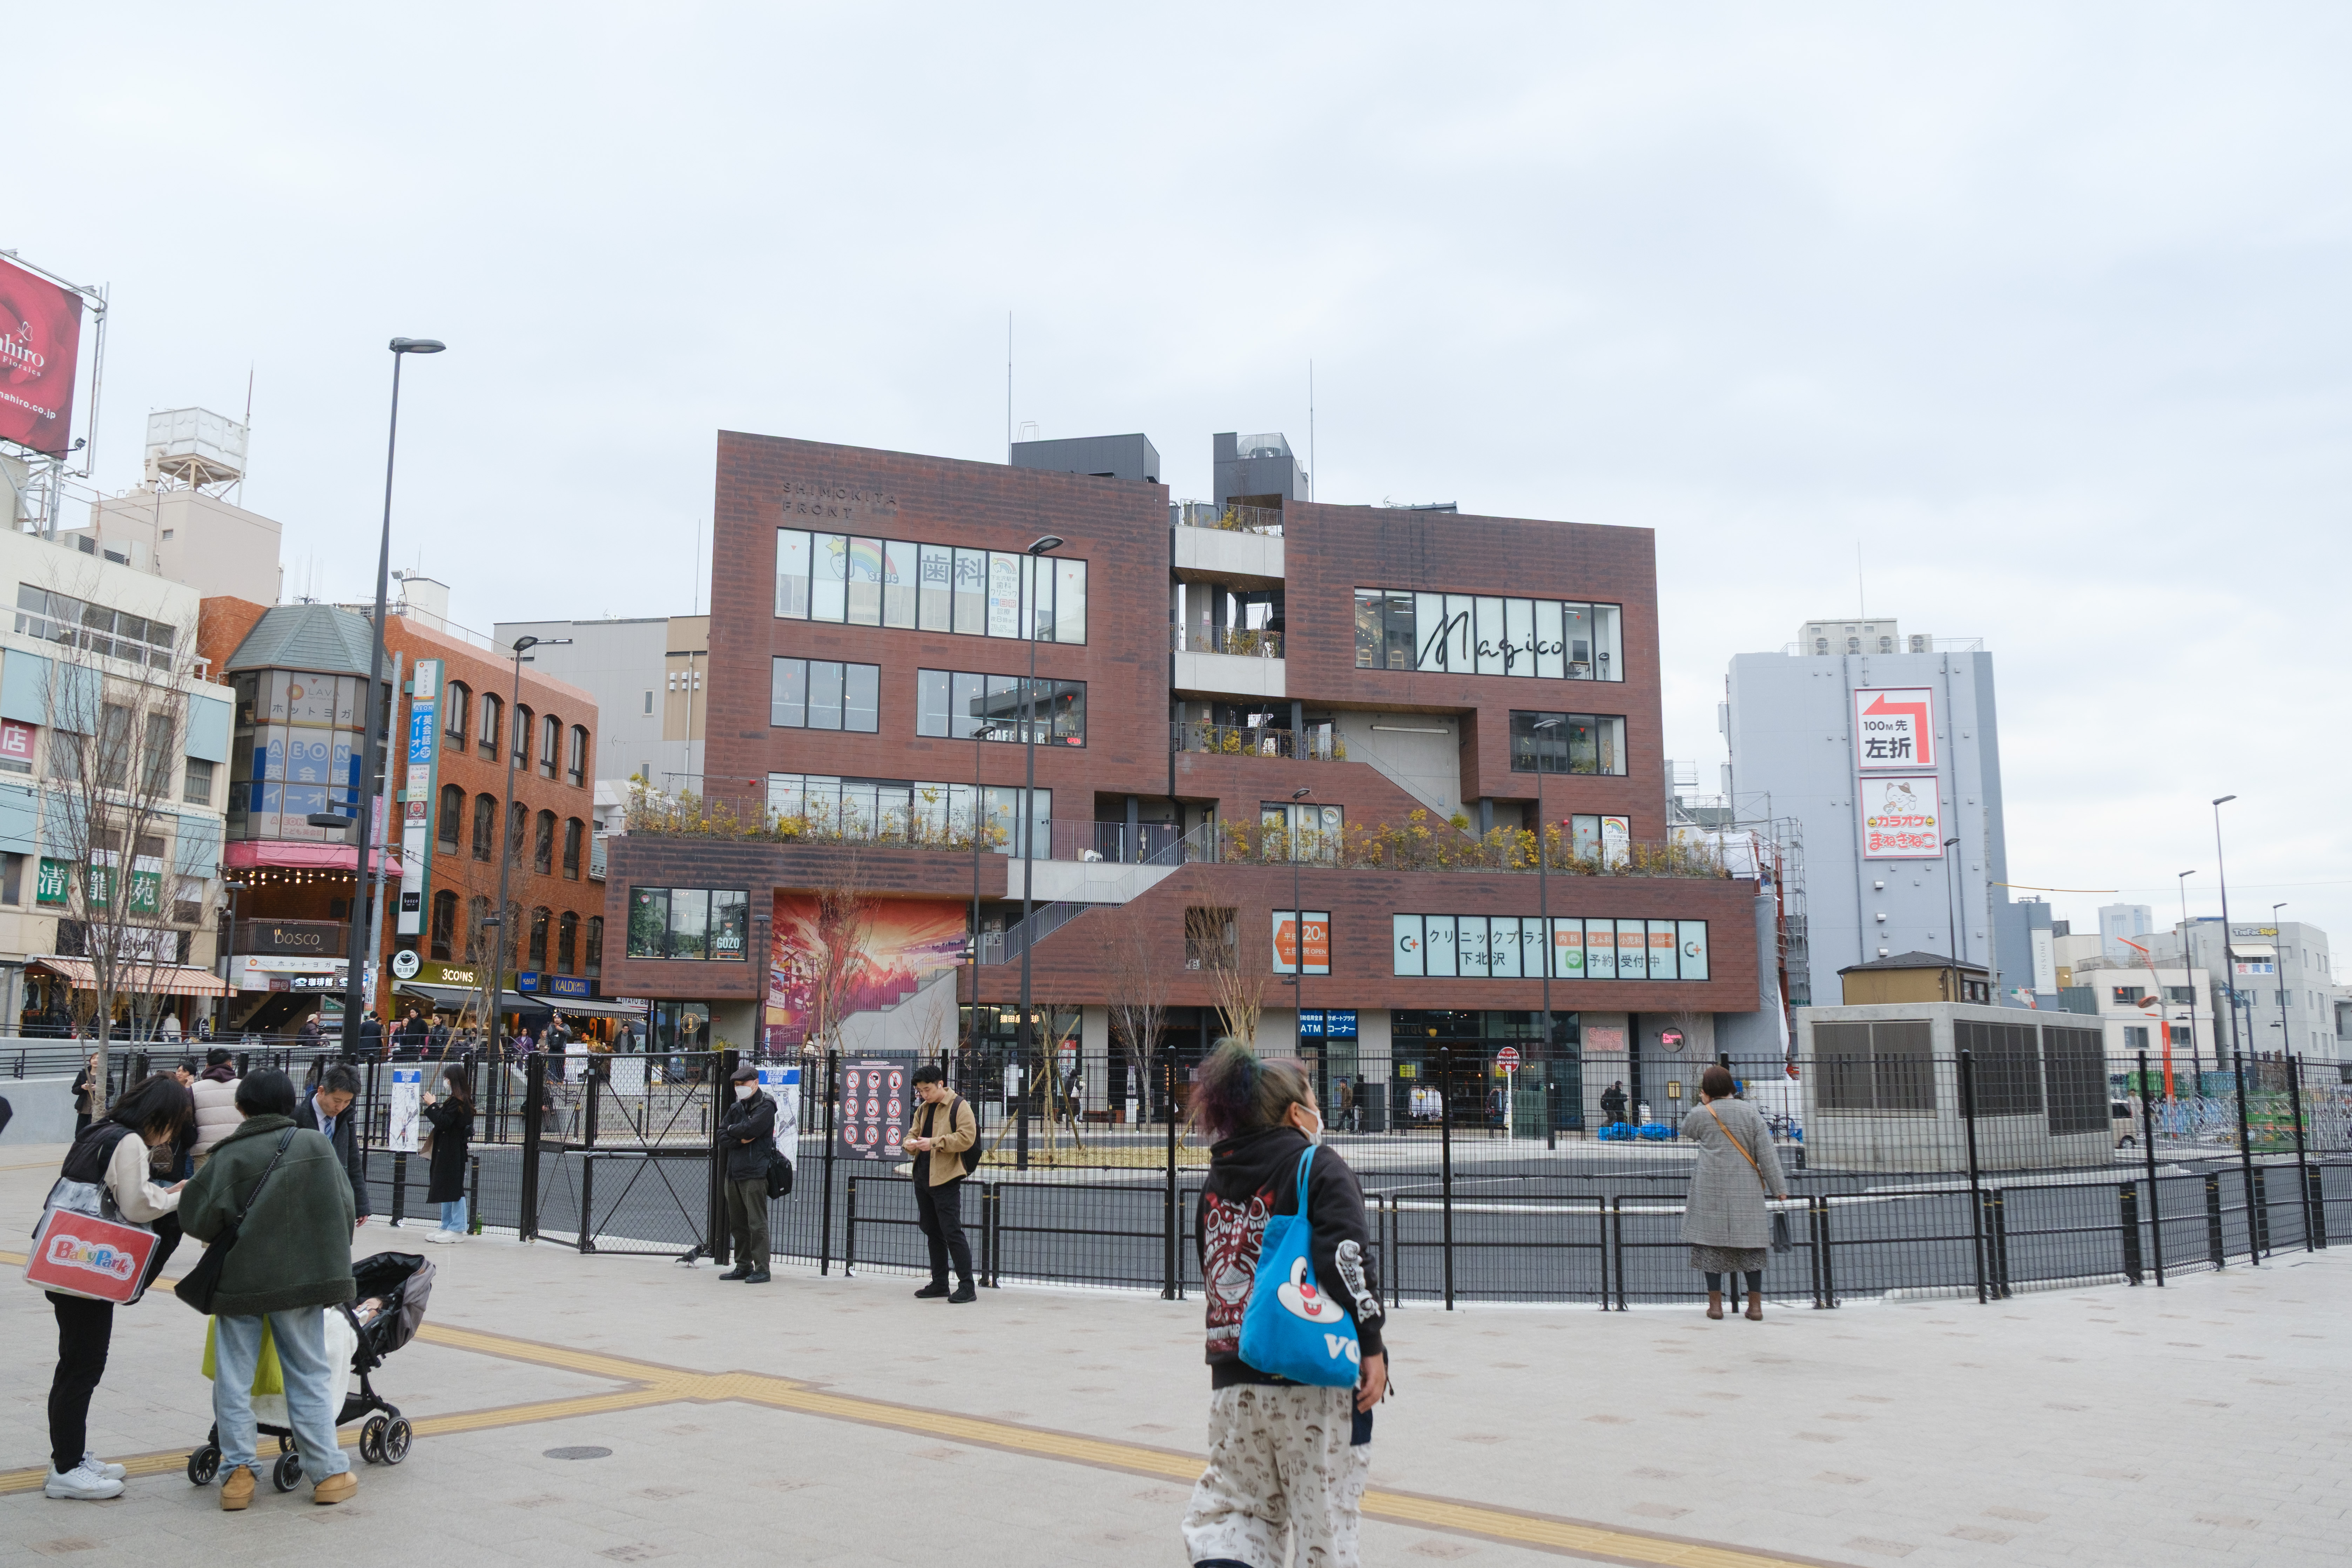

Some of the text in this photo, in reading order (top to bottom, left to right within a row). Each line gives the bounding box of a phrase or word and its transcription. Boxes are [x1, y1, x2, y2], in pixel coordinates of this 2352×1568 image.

[0, 334, 44, 367] hiro
[3, 355, 41, 377] Florales
[783, 482, 897, 504] SHIMOKITA
[783, 500, 852, 518] FRONT
[922, 553, 985, 587] 歯科
[990, 589, 1017, 597] クリニック
[991, 598, 1016, 608] 土日祝
[1417, 610, 1564, 668] Magico
[309, 688, 340, 697] LAVA
[272, 704, 352, 718] ホットヨガ
[411, 715, 422, 759] イーオン
[422, 715, 432, 745] 英会話
[986, 729, 1045, 744] CAFE BAR
[2, 725, 27, 753] 店
[267, 739, 351, 762] AEON
[421, 748, 430, 757] 3F
[1865, 736, 1912, 759] 左折
[265, 763, 349, 784] 英会話
[271, 816, 305, 826] AEON
[1877, 815, 1926, 827] カラオケ
[283, 828, 323, 836] こども英会話
[1868, 830, 1938, 850] まねきねこ
[716, 937, 740, 949] GOZO
[1429, 930, 1549, 944] クリニックプラス
[1559, 934, 1674, 945] 内科 皮ふ科 小児科 アレルギー科
[1460, 951, 1505, 966] 下北沢
[1589, 954, 1660, 968] 予約受付中
[308, 977, 333, 987] 珈琲館
[442, 968, 473, 983] 3COINS
[555, 980, 575, 992] KALDI
[1000, 1014, 1039, 1024] 猿田彦琲
[1300, 1025, 1355, 1033] ATM コーナー
[1586, 1039, 1624, 1050] AHEAD
[54, 1240, 131, 1274] BabyPark
